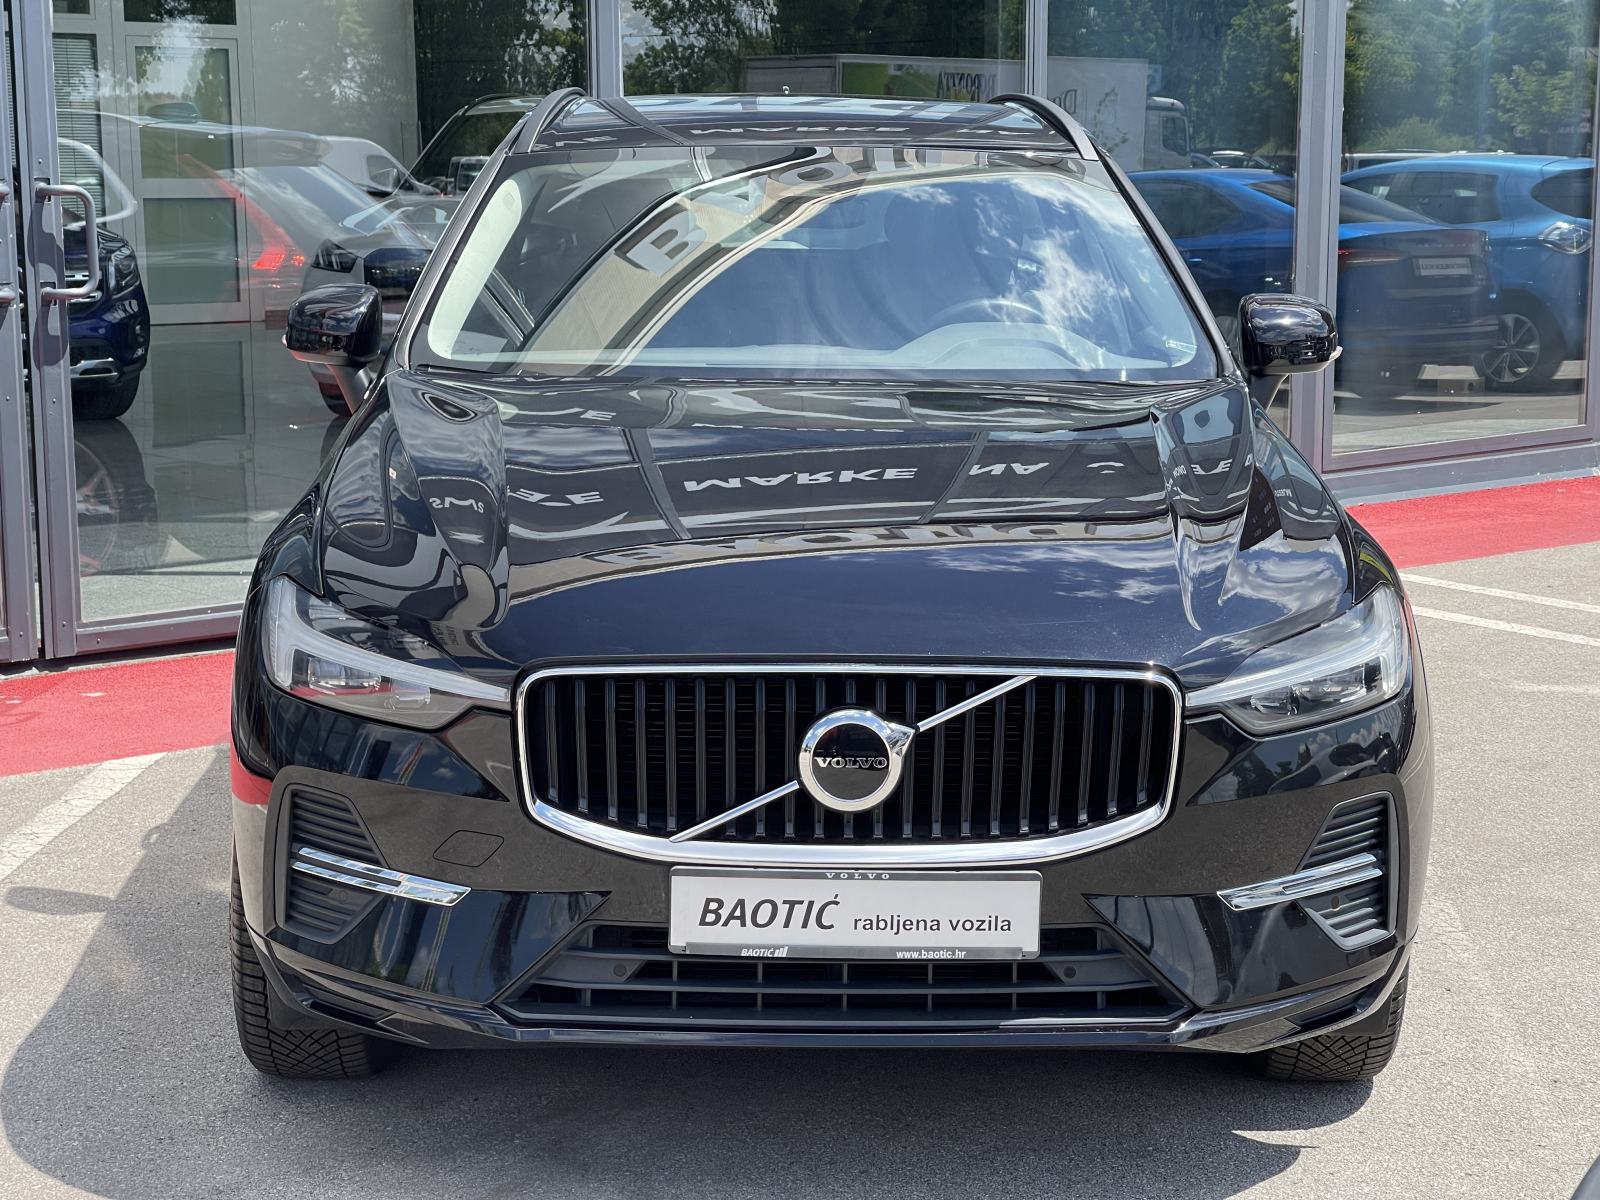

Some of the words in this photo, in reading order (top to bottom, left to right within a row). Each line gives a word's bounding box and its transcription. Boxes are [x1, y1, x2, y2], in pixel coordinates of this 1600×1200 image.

[813, 756, 888, 769] VOLVO
[825, 871, 890, 880] VOLVO
[699, 893, 841, 930] BAOTIĆ
[853, 914, 941, 936] rabljena
[948, 915, 1012, 932] vozila
[740, 947, 774, 957] BAOTIĆ
[896, 949, 967, 959] www.baotic.hr
